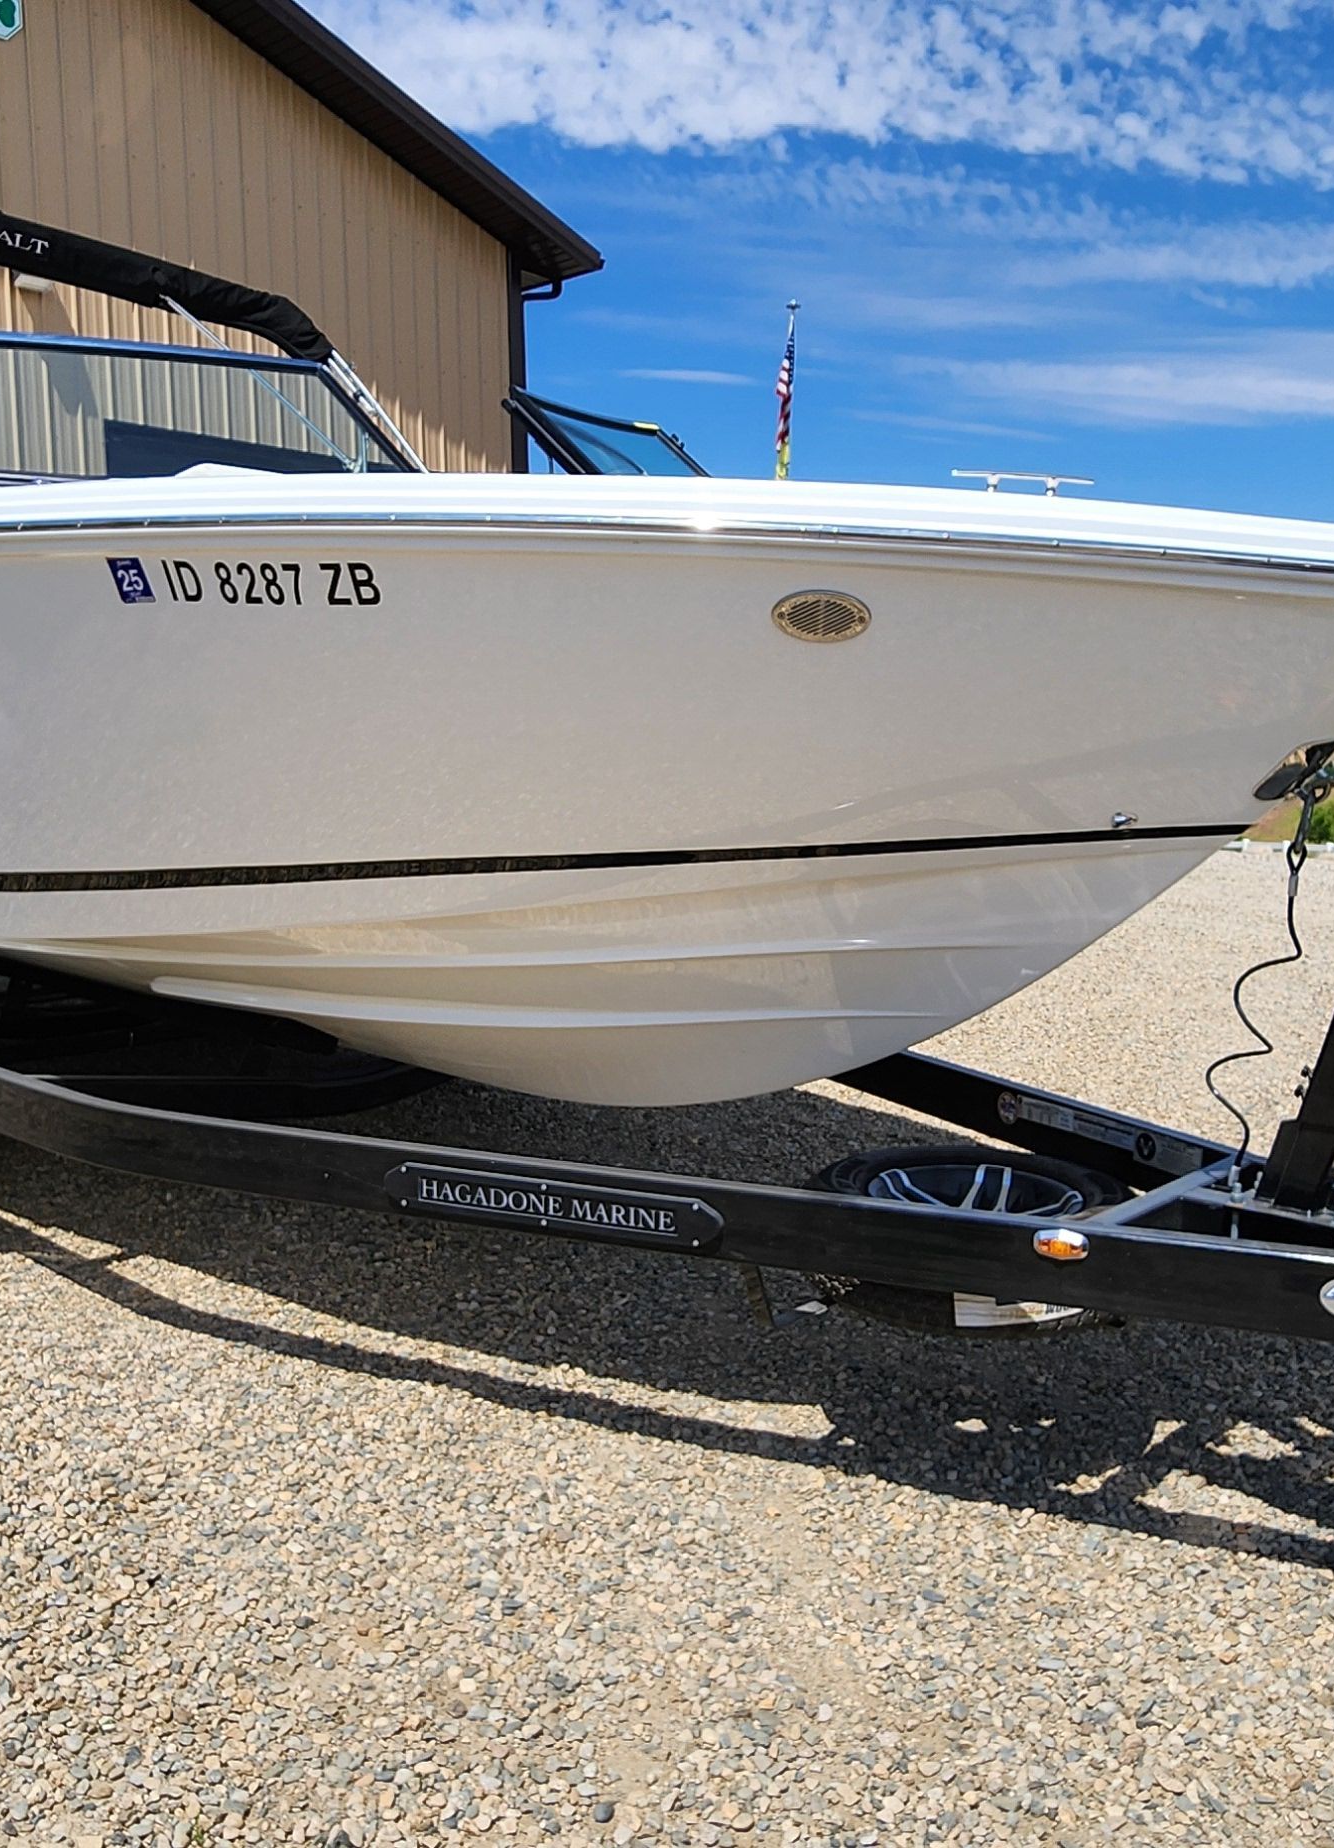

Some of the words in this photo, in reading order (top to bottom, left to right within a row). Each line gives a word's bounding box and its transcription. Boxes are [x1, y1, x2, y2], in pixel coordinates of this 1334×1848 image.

[117, 569, 144, 592] 25
[160, 560, 203, 602] ID
[214, 561, 303, 605] 8287
[319, 562, 382, 606] ZB
[419, 1177, 564, 1217] HAGADONE
[569, 1199, 676, 1232] MARINE
